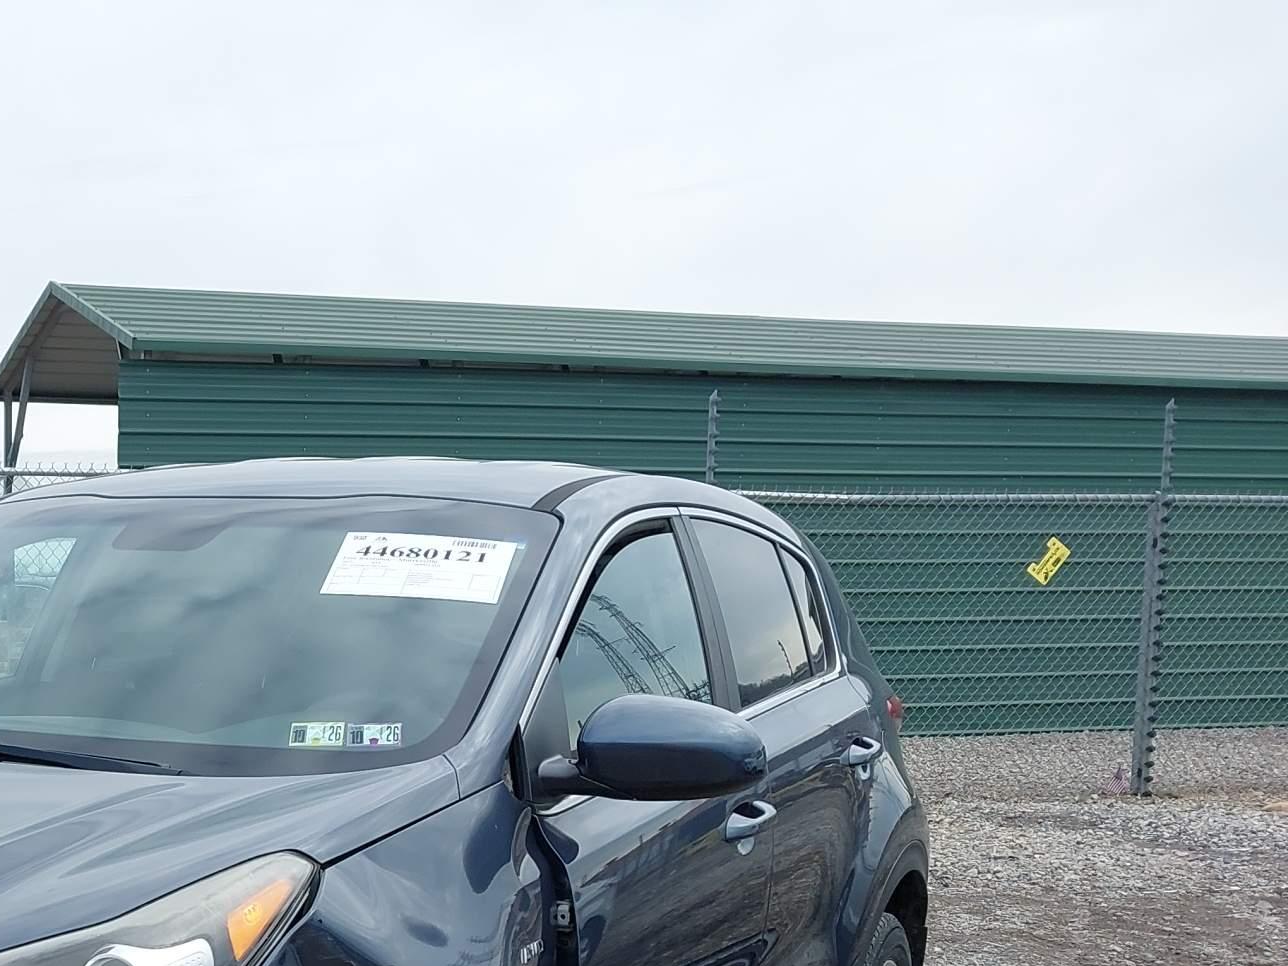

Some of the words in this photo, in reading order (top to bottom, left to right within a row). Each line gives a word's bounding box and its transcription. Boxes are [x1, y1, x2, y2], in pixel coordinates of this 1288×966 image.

[355, 544, 489, 563] 44680121
[349, 730, 364, 744] 10
[386, 725, 400, 742] 26
